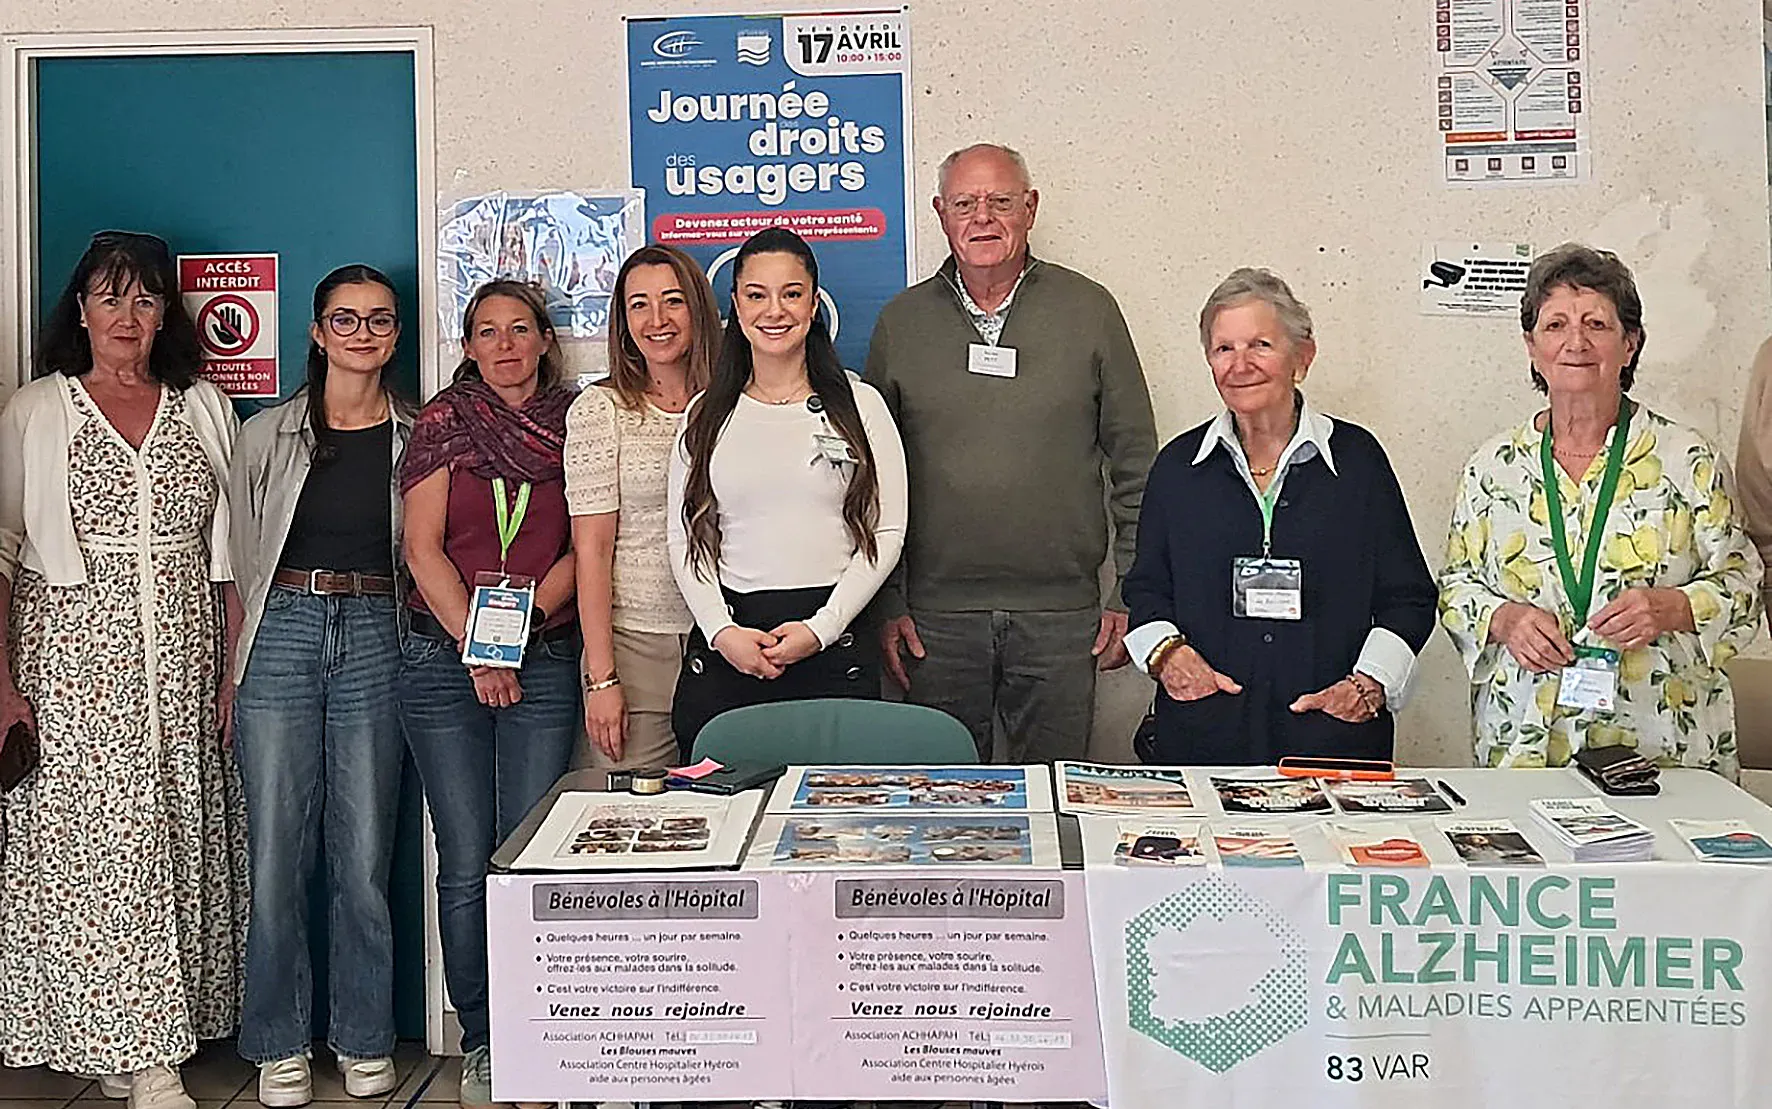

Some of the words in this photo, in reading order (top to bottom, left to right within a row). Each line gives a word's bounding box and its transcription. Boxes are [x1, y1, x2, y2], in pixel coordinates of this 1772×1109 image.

[797, 33, 834, 64] 17
[837, 32, 901, 50] AVRIL
[837, 53, 864, 62] 10:00
[874, 52, 902, 61] 15:00
[648, 80, 829, 122] Journée
[749, 117, 885, 155] droits
[666, 153, 696, 166] des
[665, 161, 866, 205] usagers
[675, 218, 729, 229] Devenez
[730, 217, 773, 227] acteur
[774, 216, 790, 225] de
[791, 216, 825, 225] votre
[827, 212, 863, 224] santé
[205, 260, 251, 273] ACCÈS
[196, 276, 260, 288] INTERDIT
[216, 363, 252, 371] TOUTES
[247, 372, 271, 380] NON
[549, 890, 644, 910] Bénévoles
[650, 892, 660, 908] à
[665, 889, 744, 912] l'Hôpital
[851, 888, 947, 907] Bénévoles
[952, 890, 964, 906] à
[969, 888, 1051, 911] l'Hôpital
[1327, 874, 1617, 930] FRANCE
[547, 933, 593, 943] Quelques
[596, 933, 629, 942] heures
[659, 932, 677, 943] jour
[681, 933, 696, 942] par
[849, 930, 896, 941] Quelques
[899, 931, 933, 940] heures
[947, 932, 960, 940] un
[963, 932, 982, 942] jour
[985, 933, 1001, 942] par
[546, 954, 572, 962] Votre
[624, 954, 649, 962] votre
[849, 952, 875, 961] Votre
[928, 952, 954, 961] votre
[1325, 931, 1745, 991] ALZHEIMER
[594, 965, 611, 973] aux
[614, 964, 656, 973] malades
[658, 963, 682, 972] dans
[685, 963, 694, 972] la
[897, 963, 914, 971] aux
[917, 962, 960, 971] malades
[962, 962, 987, 972] dans
[989, 962, 998, 972] la
[547, 984, 572, 993] C'est
[574, 985, 598, 993] votre
[601, 984, 636, 993] victoire
[639, 985, 655, 993] sur
[849, 982, 874, 992] C'est
[876, 983, 901, 991] votre
[904, 983, 941, 991] victoire
[549, 1003, 600, 1017] Venez
[611, 1005, 653, 1017] nous
[665, 1002, 745, 1020] rejoindre
[851, 1002, 903, 1016] Venez
[915, 1004, 957, 1016] nous
[969, 1002, 1051, 1020] rejoindre
[1326, 994, 1347, 1020] &
[1358, 992, 1512, 1019] MALADIES
[1523, 994, 1747, 1026] APPARENTÉES
[543, 1031, 597, 1041] Association
[844, 1030, 900, 1040] Association
[601, 1046, 617, 1055] Les
[620, 1046, 657, 1055] Blouses
[904, 1045, 920, 1054] Les
[922, 1045, 961, 1054] Blouses
[963, 1048, 1001, 1056] mauves
[559, 1059, 614, 1069] Association
[616, 1059, 648, 1069] Centre
[650, 1060, 701, 1071] Hospitalier
[861, 1058, 917, 1069] Association
[919, 1058, 951, 1069] Centre
[953, 1059, 1006, 1071] Hospitalier
[1008, 1060, 1045, 1073] Hyérois
[1326, 1055, 1364, 1082] 83
[1372, 1053, 1430, 1080] VAR
[589, 1074, 609, 1083] aide
[611, 1075, 628, 1083] aux
[631, 1075, 680, 1085] personnes
[682, 1074, 711, 1085] âgées
[891, 1073, 912, 1082] aide
[934, 1074, 984, 1083] personnes
[986, 1074, 1016, 1086] âgées
